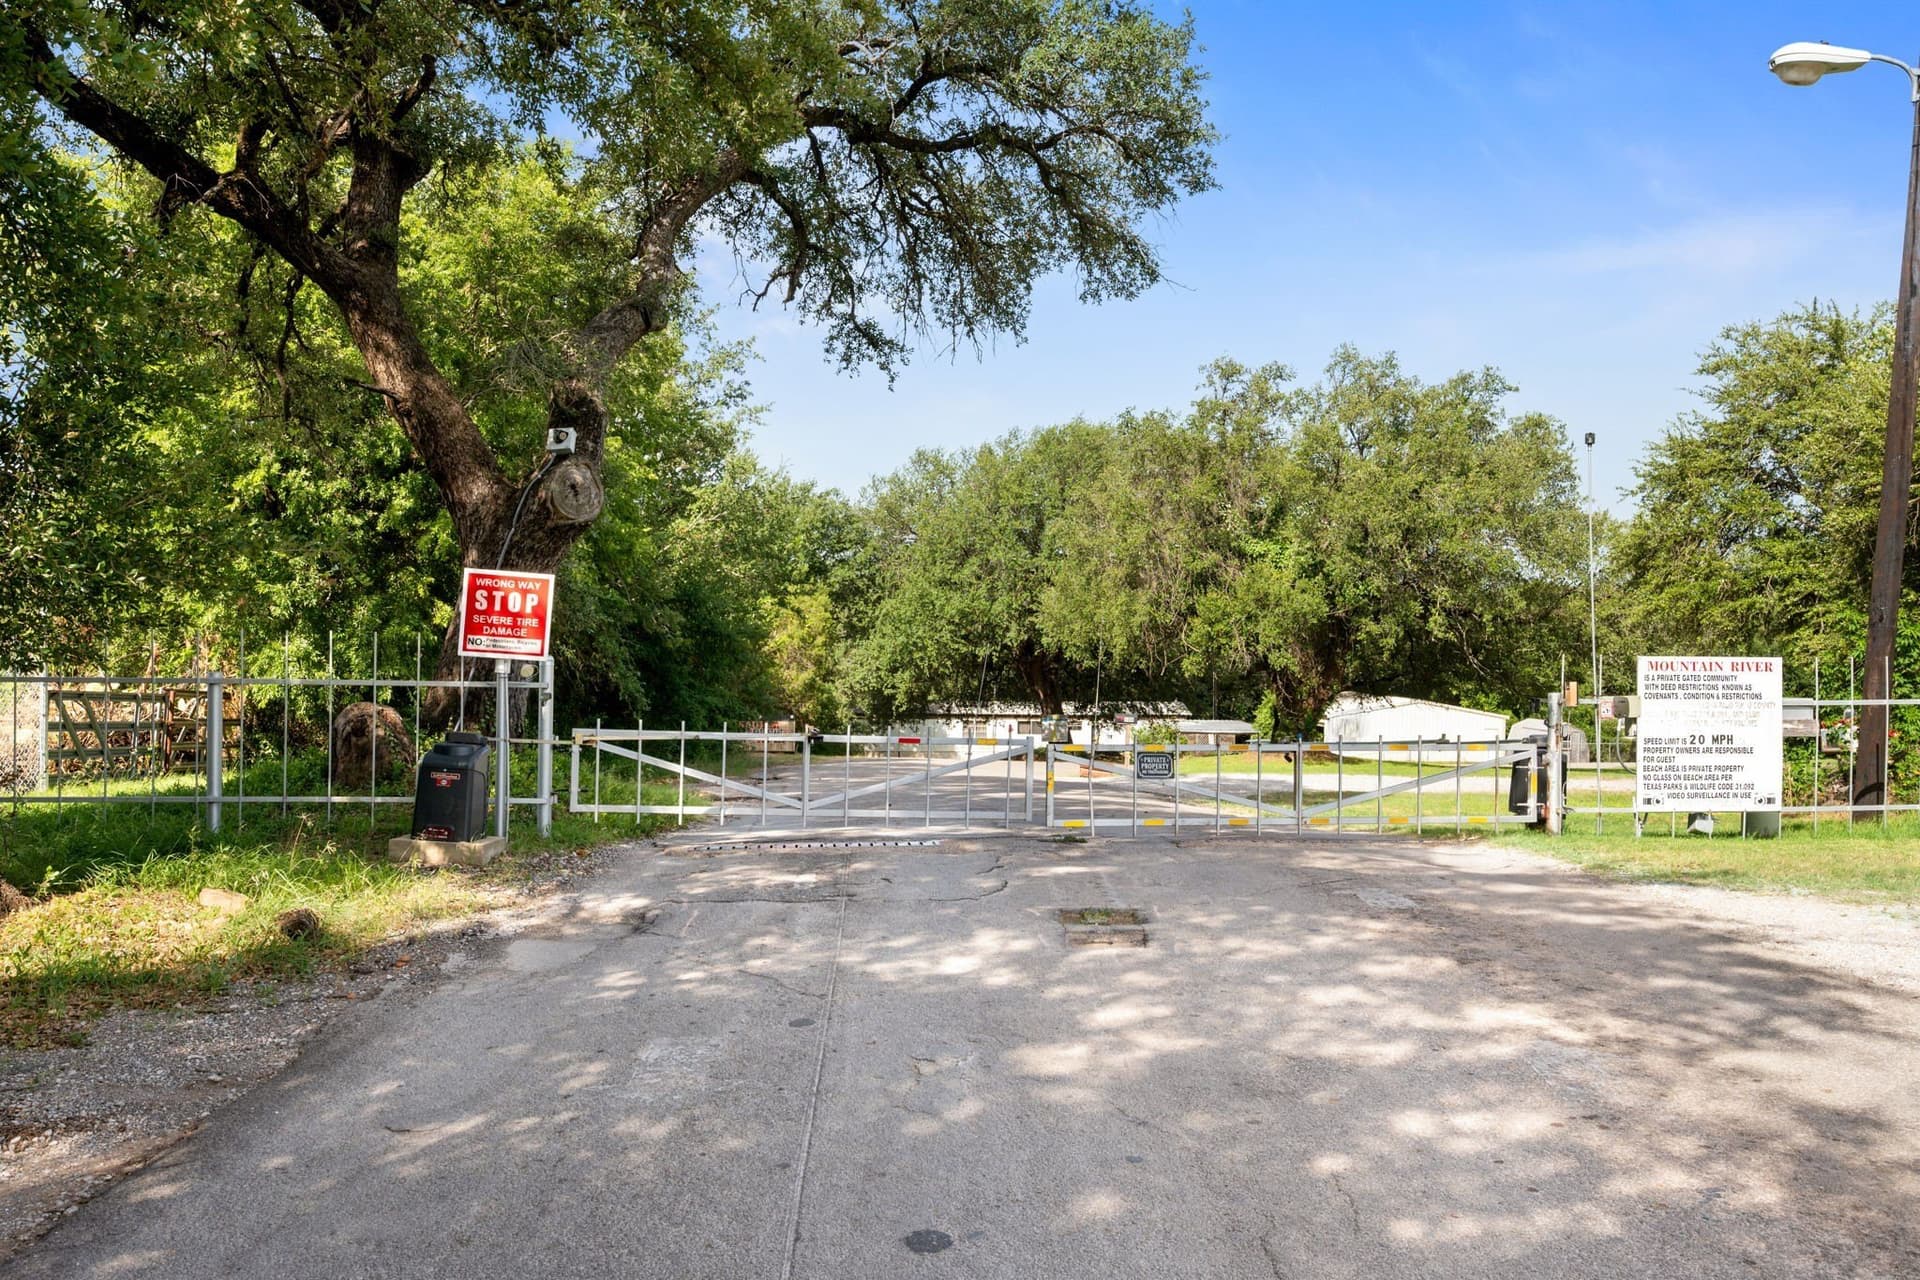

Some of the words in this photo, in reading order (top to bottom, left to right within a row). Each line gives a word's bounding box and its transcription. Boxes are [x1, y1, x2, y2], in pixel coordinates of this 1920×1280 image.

[476, 578, 515, 588] WRONG
[518, 580, 541, 590] WAY
[475, 589, 538, 614] STOP
[473, 615, 513, 625] SEVERE
[516, 617, 539, 627] TIRE
[483, 626, 528, 637] DAMAGE
[1648, 661, 1723, 672] MOUNTAIN
[1731, 661, 1774, 672] RIVER
[1644, 683, 1659, 691] WITH
[1661, 683, 1676, 691] DEED
[1678, 683, 1719, 691] RESTRICTIONS
[1721, 683, 1743, 691] KNOWN
[1744, 683, 1752, 691] AS
[1643, 692, 1678, 700] COVENANTS
[1683, 692, 1715, 700] CONDITION
[1722, 692, 1762, 700] RESTRICTIONS
[1689, 734, 1705, 745] 20
[1712, 734, 1733, 745] MPH
